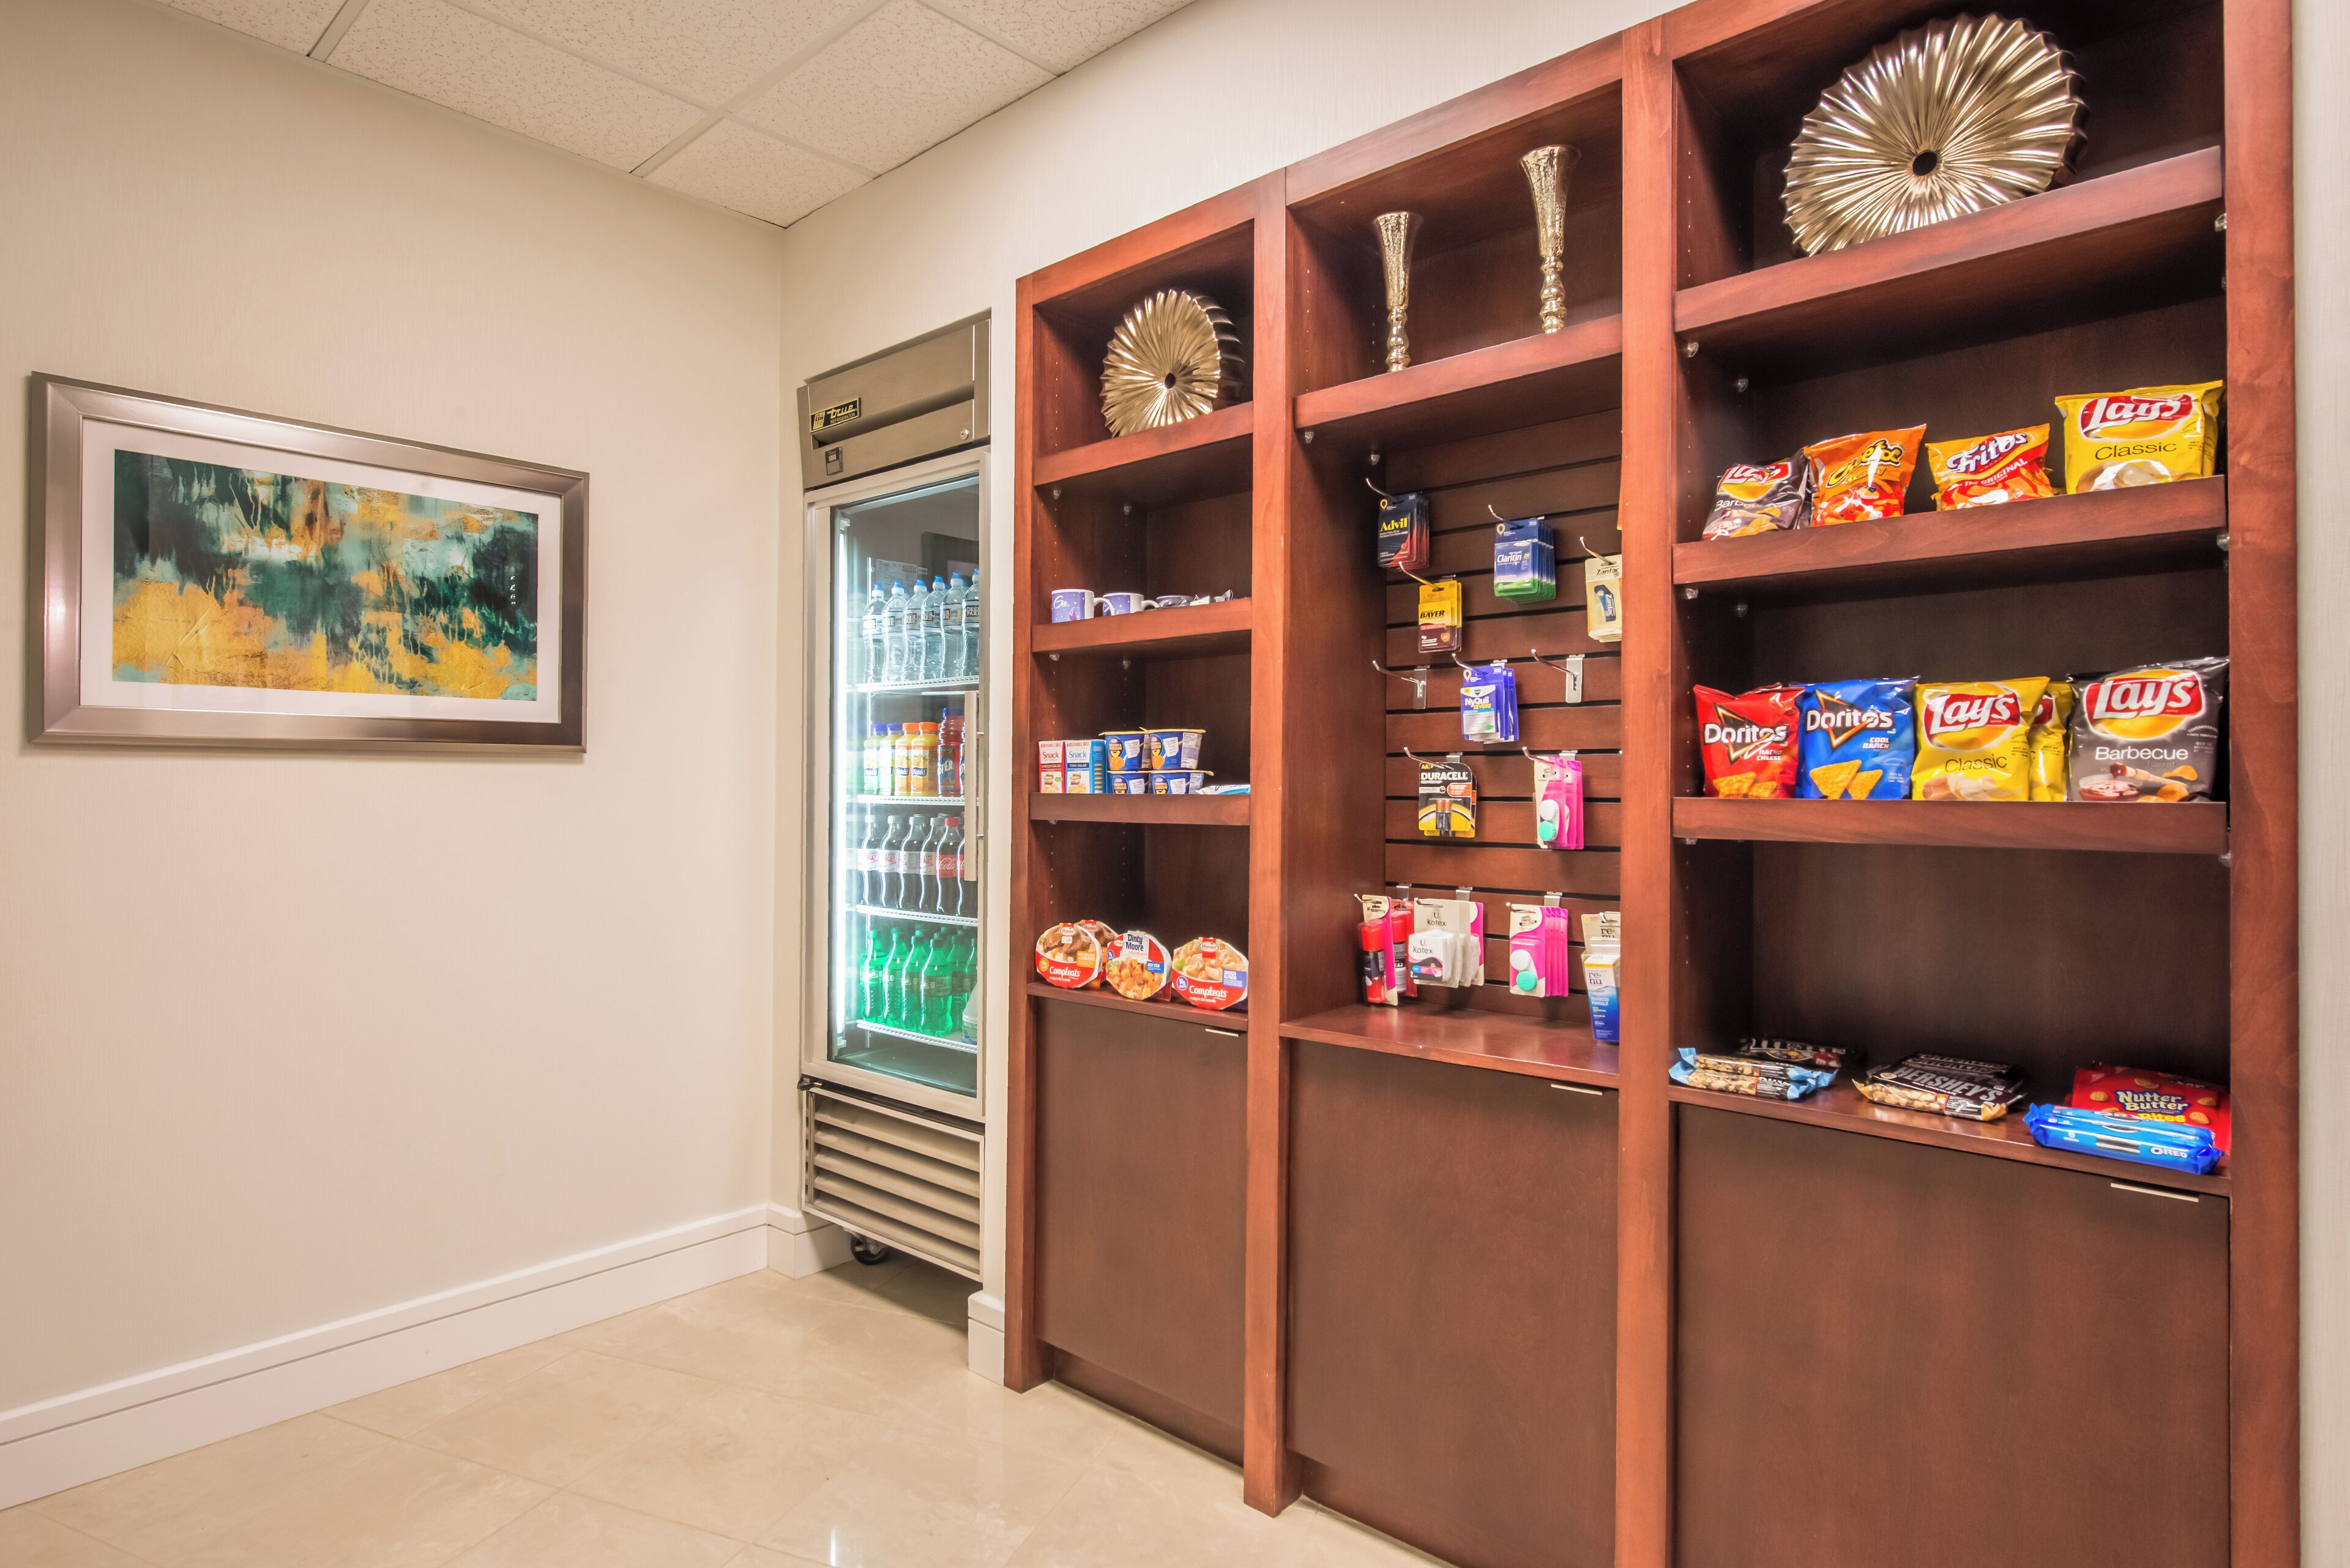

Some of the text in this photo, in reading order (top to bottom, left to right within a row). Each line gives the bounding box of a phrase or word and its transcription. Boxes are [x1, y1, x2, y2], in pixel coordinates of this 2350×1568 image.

[827, 405, 855, 419] true
[830, 413, 856, 424] REFRIGERATOR
[1946, 433, 2028, 472] Fritos
[2095, 442, 2177, 460] Classic
[1981, 458, 2028, 484] ORIGINAL
[1380, 517, 1408, 532] Advil
[1497, 553, 1522, 563] Claritin
[1420, 610, 1445, 619] BAYER
[1464, 696, 1490, 707] NyQuil
[1807, 709, 1893, 731] Doritos
[1930, 694, 2015, 734] Lay's
[1704, 723, 1787, 744] Doritos
[2095, 746, 2188, 760] Barbecue
[1945, 754, 2007, 772] Classic
[1421, 772, 1468, 780] DURACELL
[939, 858, 956, 870] Cola
[1127, 934, 1143, 944] Dinty
[1126, 942, 1144, 951] Moore
[1049, 966, 1080, 977] Compleats
[1189, 985, 1227, 998] Compleats
[1893, 1066, 2003, 1102] HERSHEY'S
[1925, 1085, 1957, 1096] CHOCOLATE
[2116, 1091, 2182, 1103] Nutter
[2124, 1101, 2188, 1111] Butter
[2138, 1113, 2186, 1122] Bites
[2150, 1146, 2188, 1158] OREO
